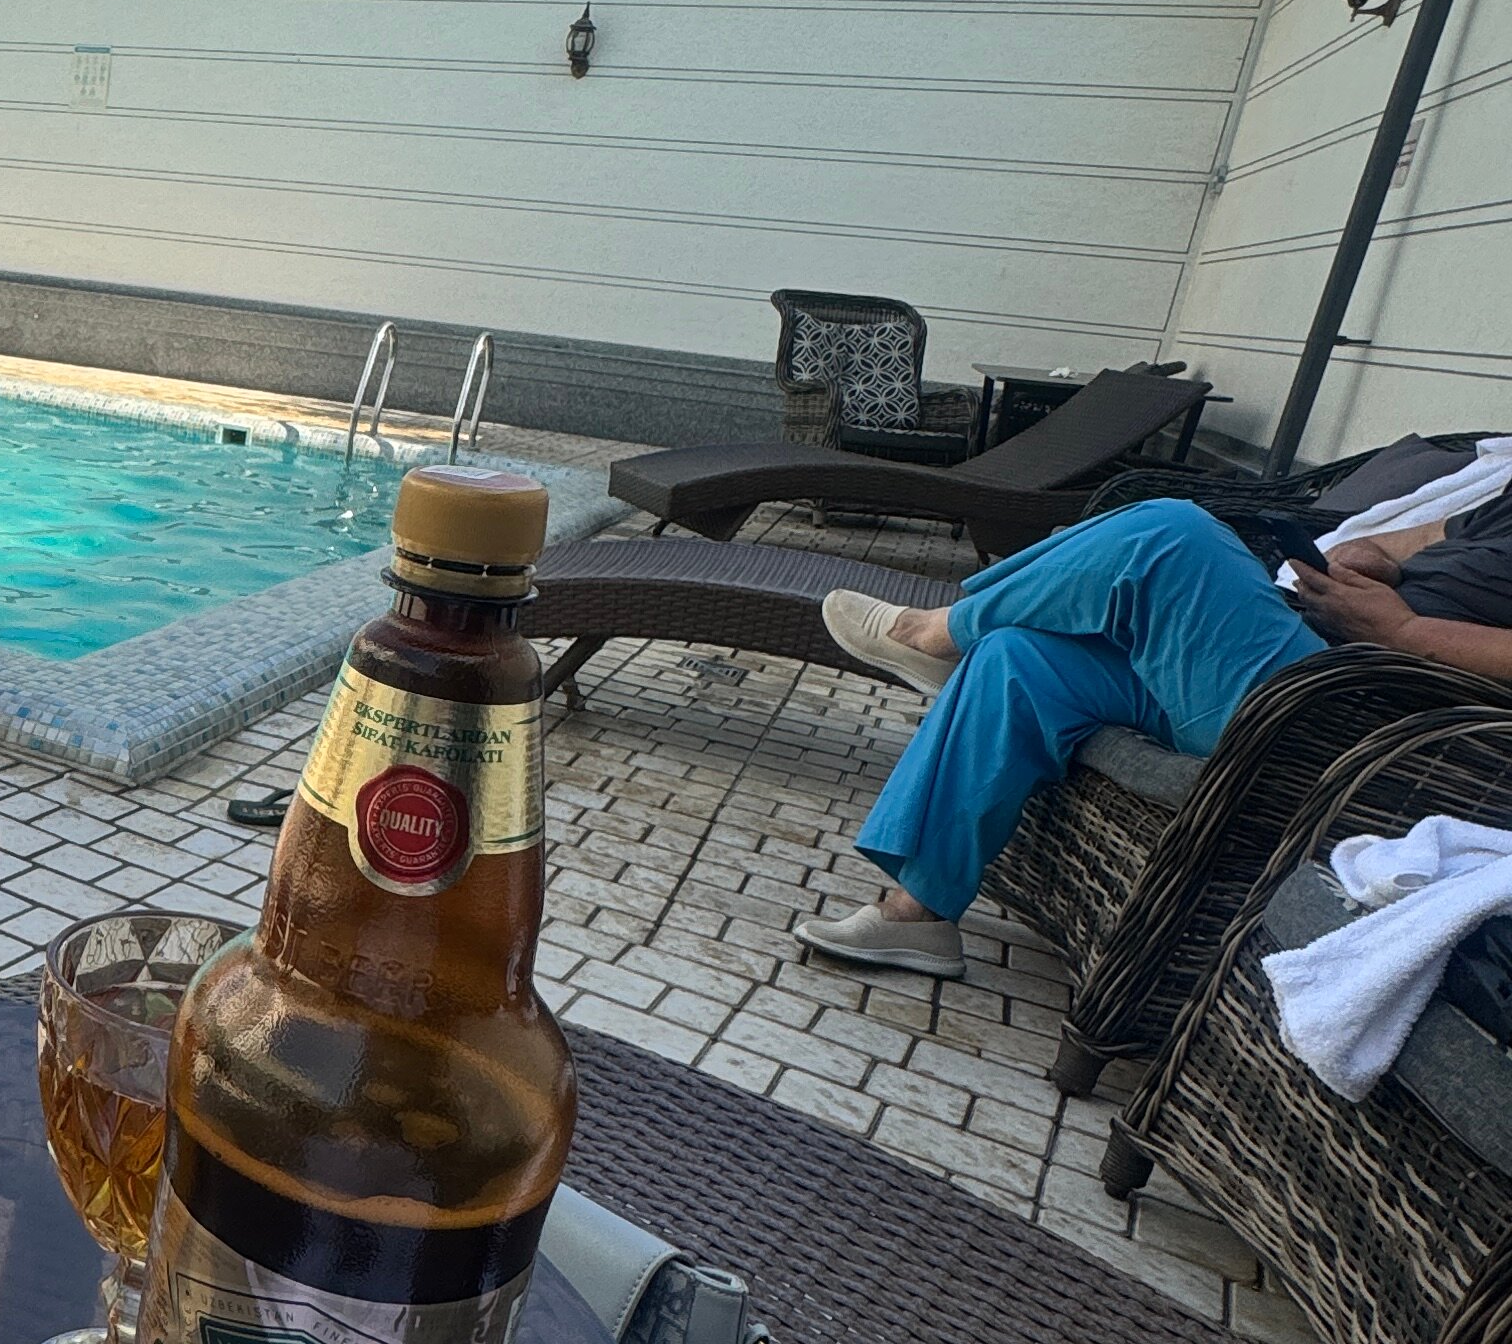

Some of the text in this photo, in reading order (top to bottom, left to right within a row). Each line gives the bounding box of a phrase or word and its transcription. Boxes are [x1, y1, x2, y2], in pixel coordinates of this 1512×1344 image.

[353, 700, 512, 745] EKSPERTLARDAN
[351, 721, 504, 763] SIFAT KAFOLATI
[379, 808, 445, 838] QUALITY
[200, 1292, 295, 1323] UZBEKISTAN
